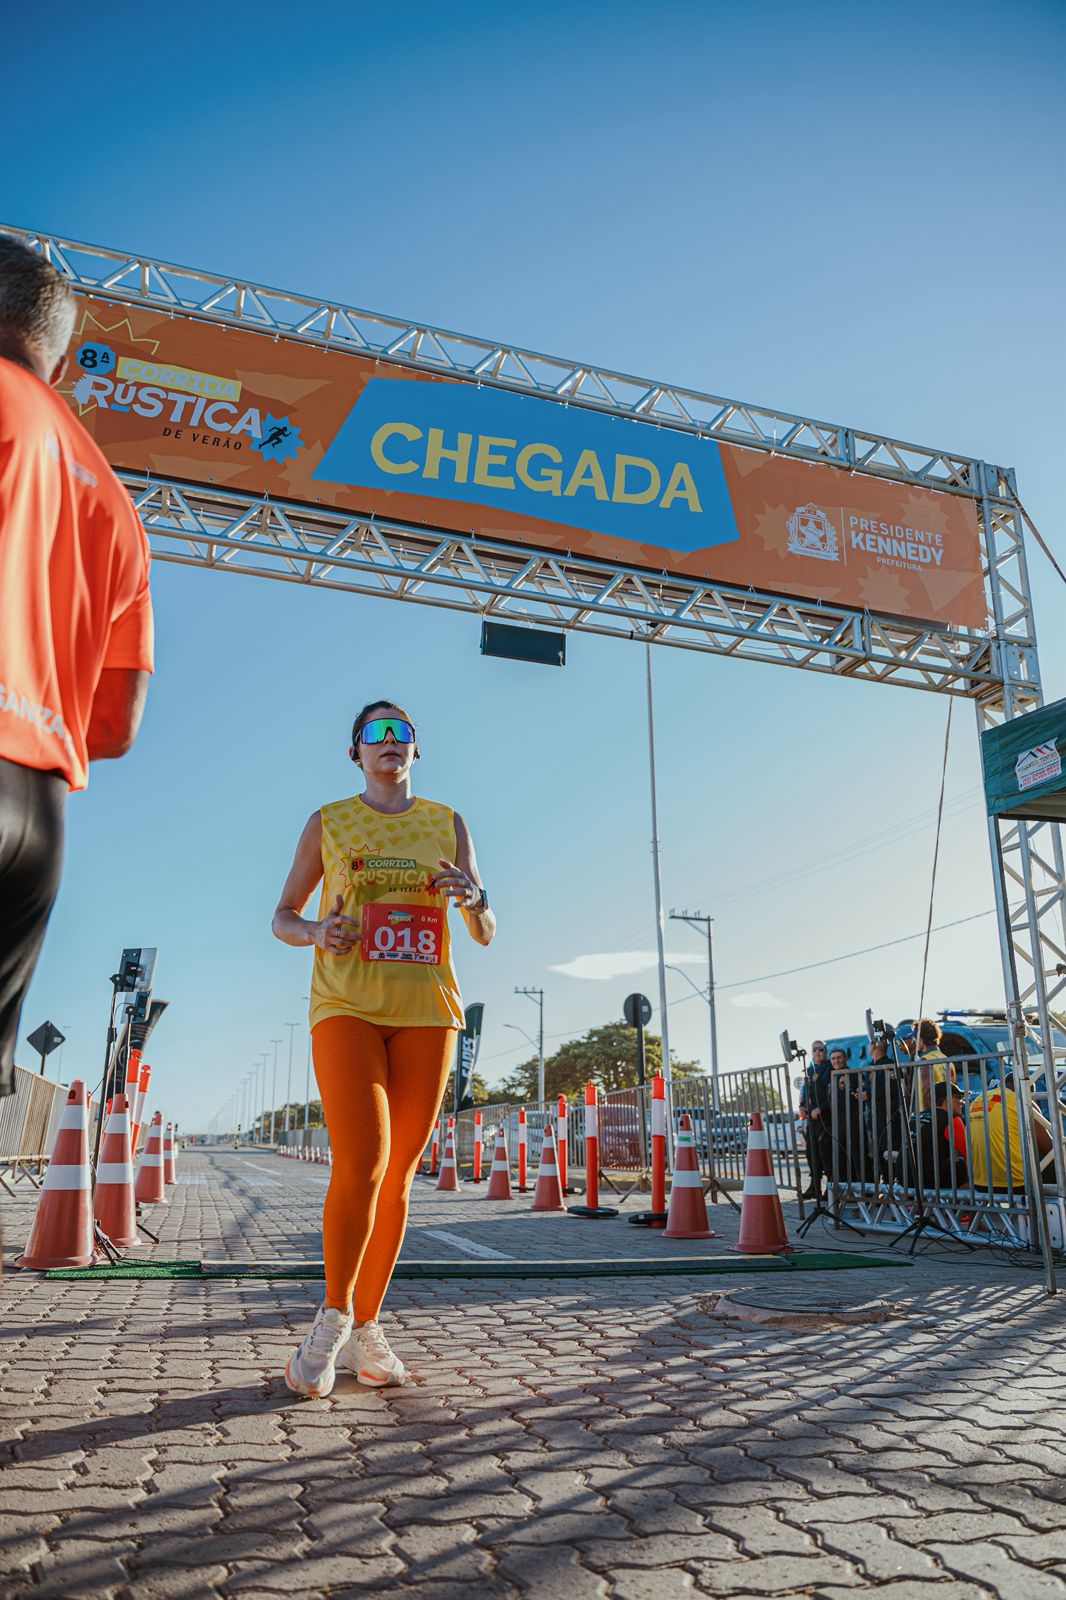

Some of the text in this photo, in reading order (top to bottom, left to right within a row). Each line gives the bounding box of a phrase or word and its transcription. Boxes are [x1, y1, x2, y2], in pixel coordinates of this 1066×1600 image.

[123, 361, 236, 399] CORRIDA
[75, 373, 263, 438] RÚSTICA
[162, 427, 242, 451] DE VERÃO
[370, 422, 703, 513] CHEGADA
[849, 515, 944, 547] PRESIDENTE
[850, 530, 944, 565] KENNEDY
[876, 556, 923, 571] PREFEITURA
[353, 869, 429, 886] RÚSTICA
[368, 859, 416, 869] CORRIDA
[374, 926, 436, 954] 018
